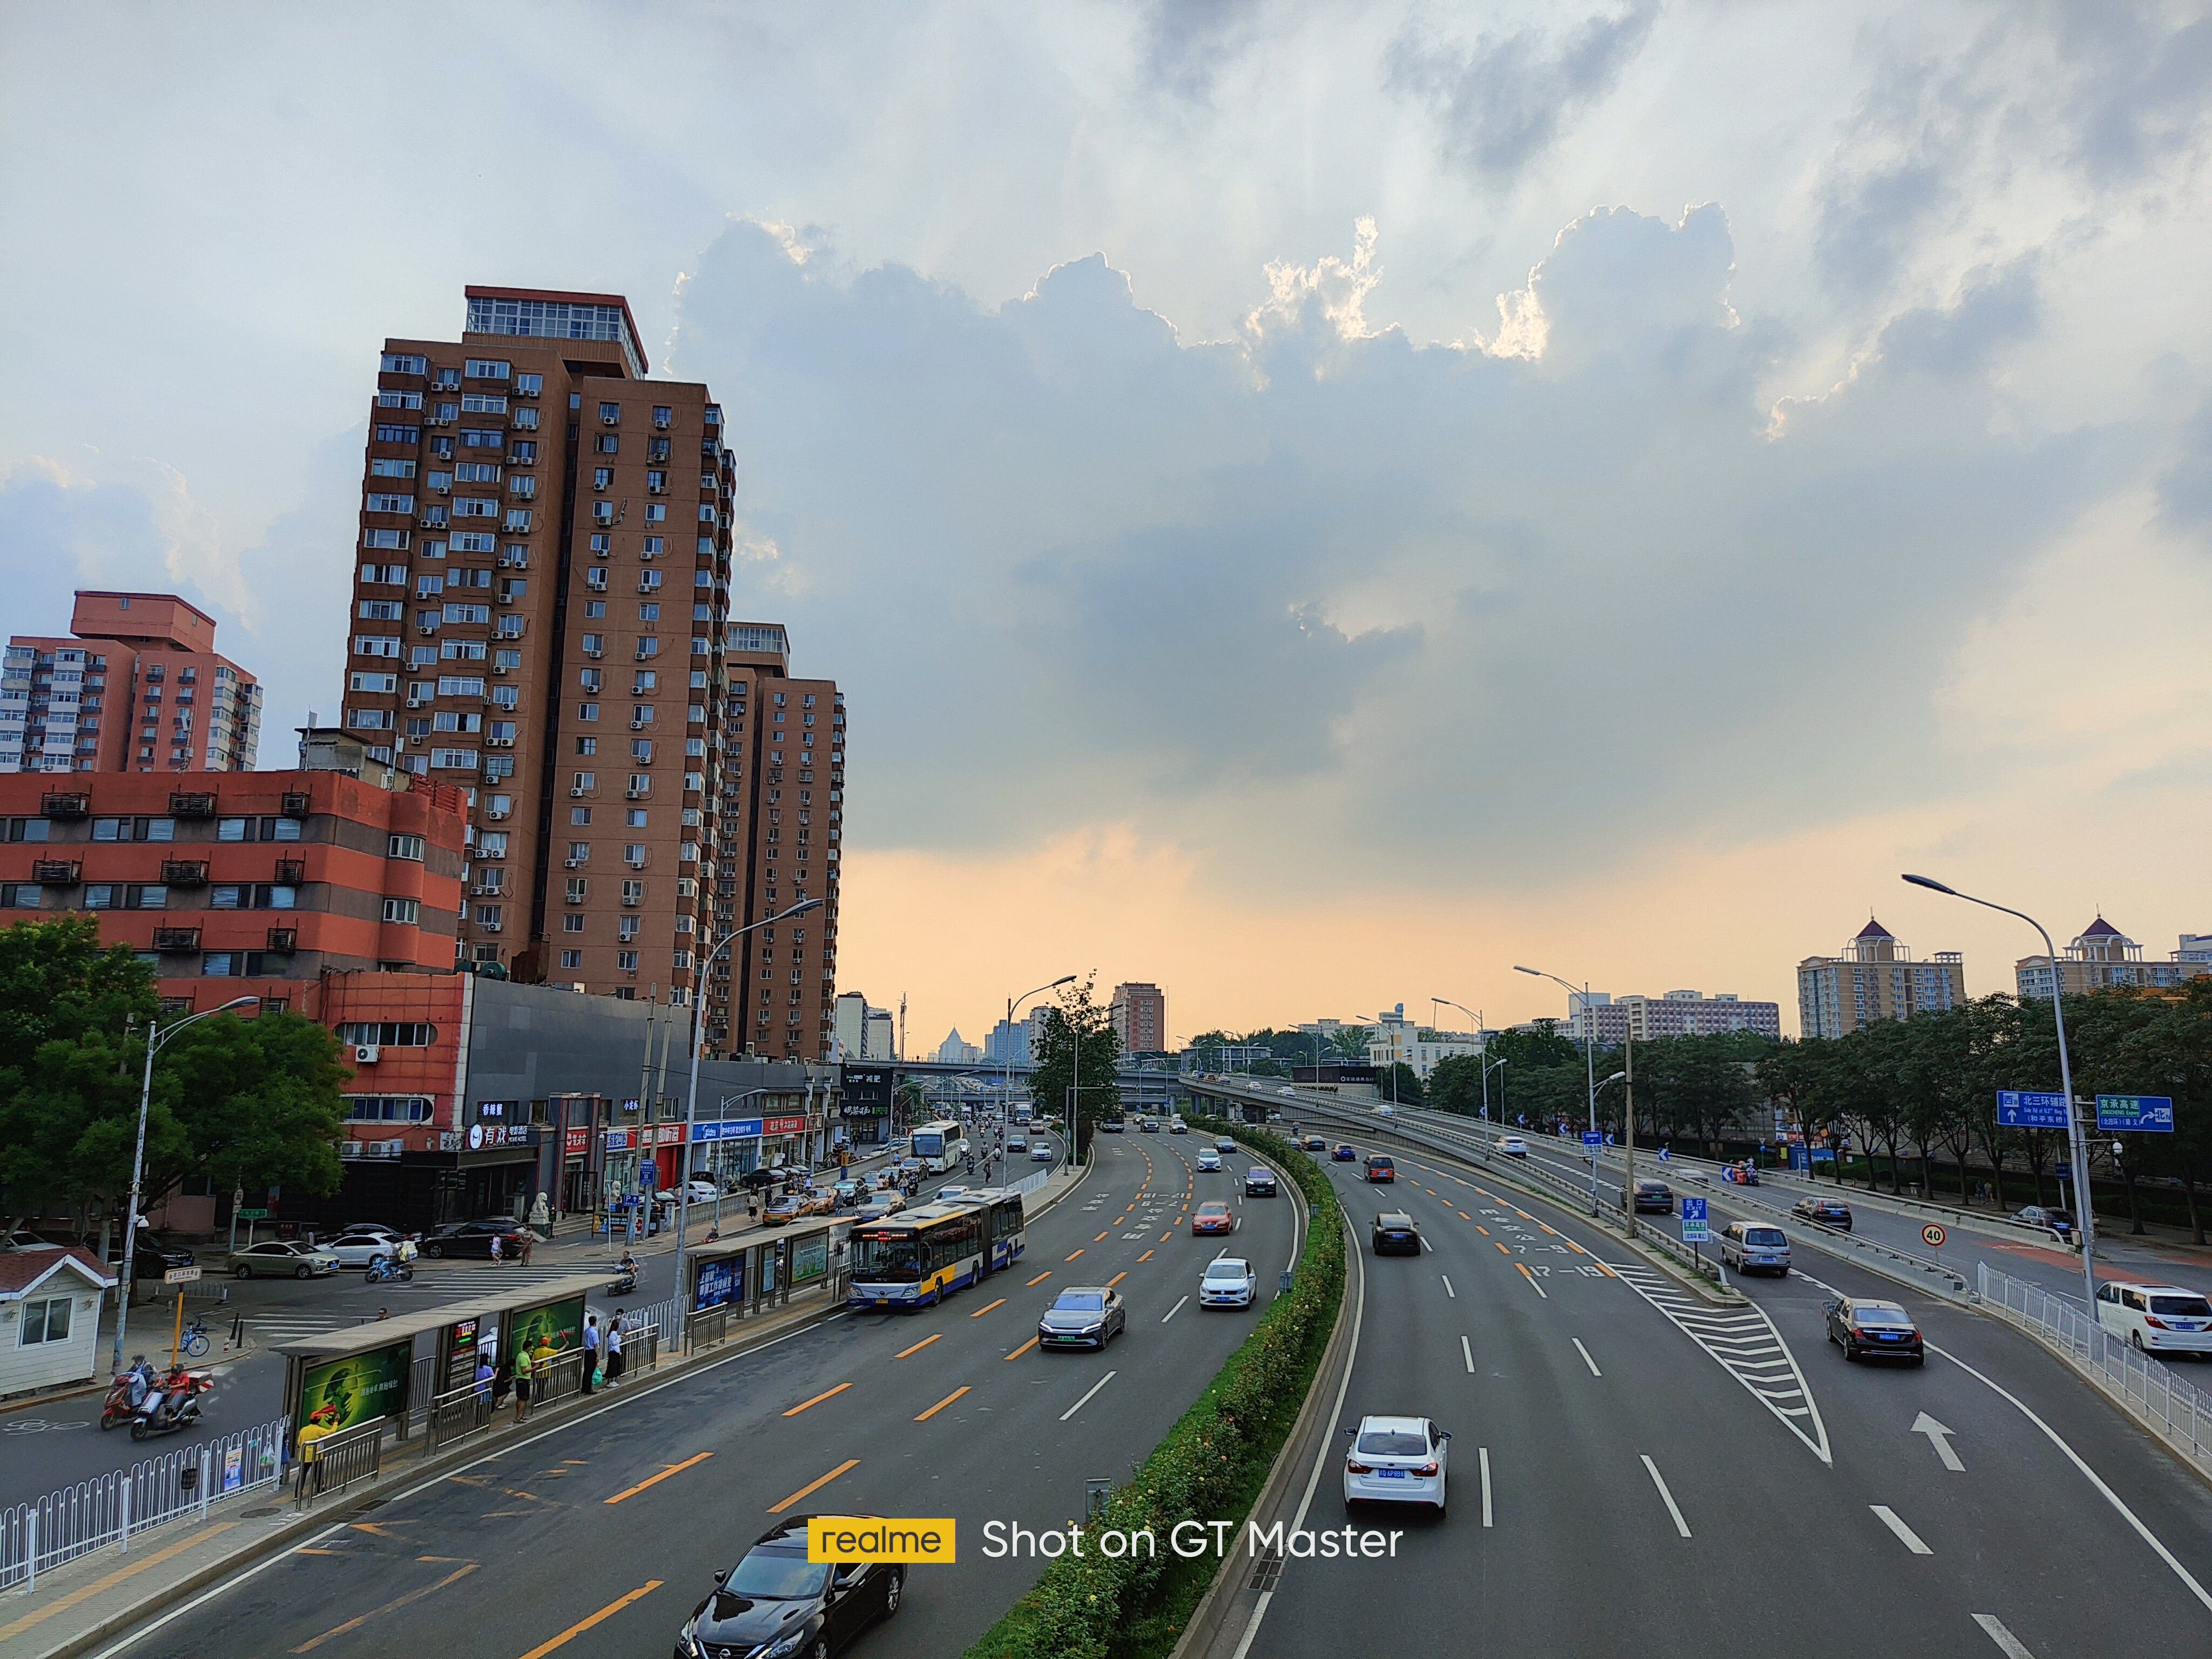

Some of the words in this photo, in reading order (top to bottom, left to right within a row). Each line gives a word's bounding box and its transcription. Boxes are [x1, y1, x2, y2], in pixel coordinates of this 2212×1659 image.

[866, 1075, 881, 1083] 减肥
[624, 1100, 639, 1110] 小龙虾
[2004, 1096, 2013, 1104] 西
[2023, 1095, 2067, 1107] 北三环辅路
[2100, 1098, 2139, 1110] 京承高速
[483, 1103, 503, 1116] 香辣蟹
[2155, 1110, 2165, 1120] 北
[485, 1125, 507, 1144] 有戏
[509, 1125, 528, 1135] 电影酒店
[703, 1124, 716, 1139] Midea
[1926, 1230, 1941, 1240] 40
